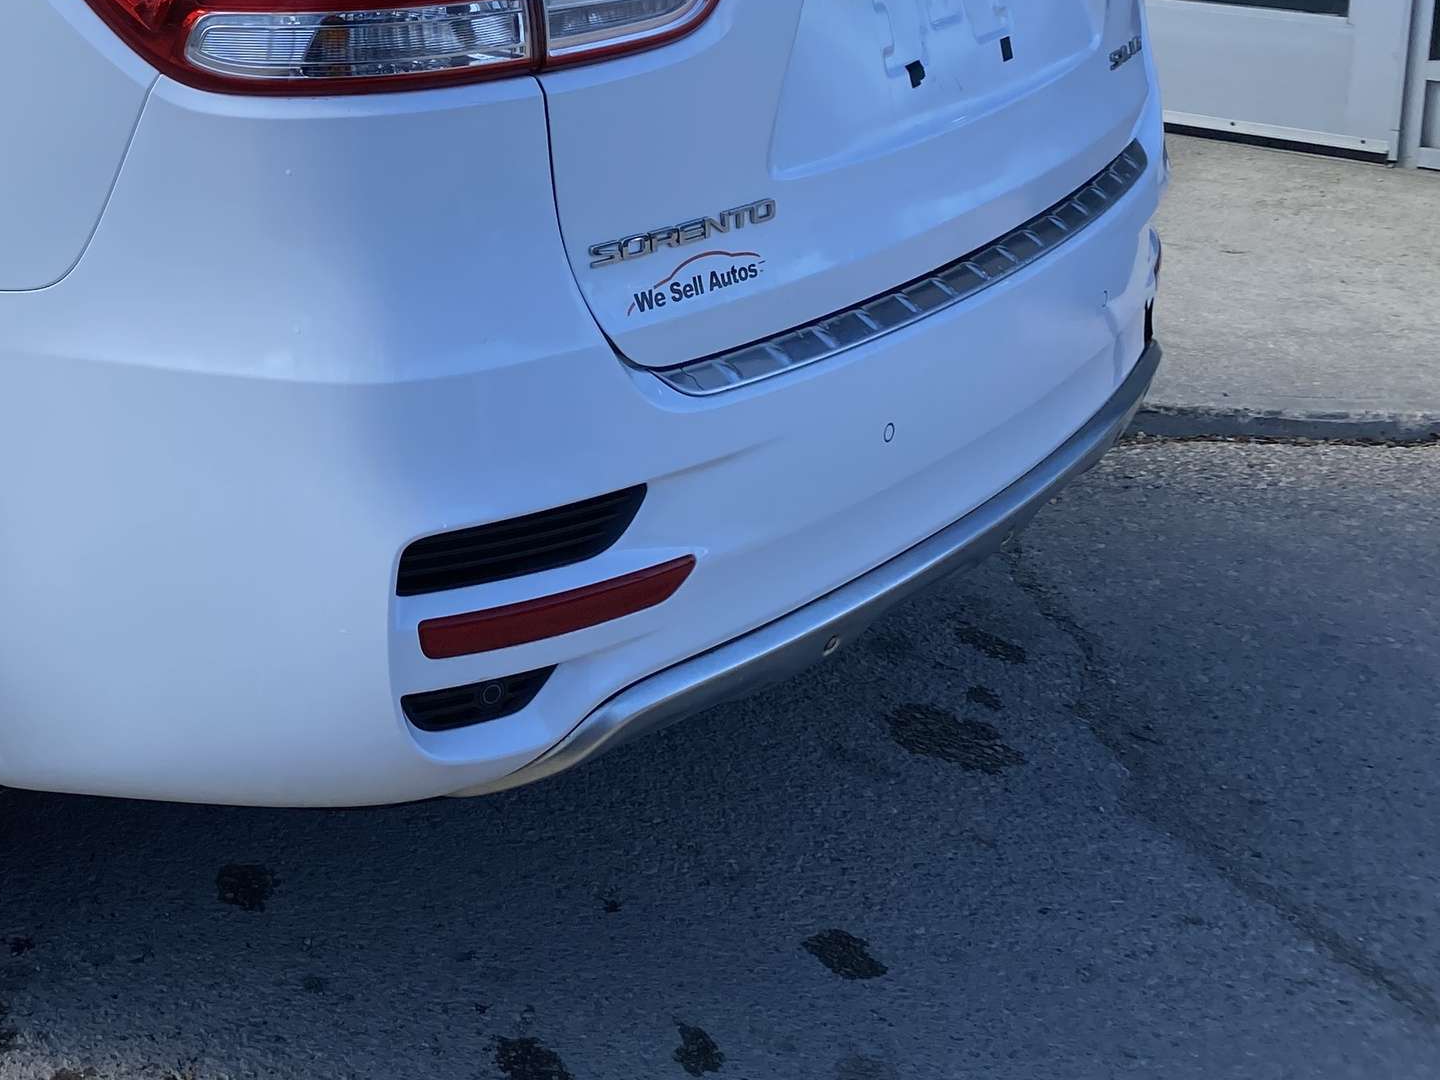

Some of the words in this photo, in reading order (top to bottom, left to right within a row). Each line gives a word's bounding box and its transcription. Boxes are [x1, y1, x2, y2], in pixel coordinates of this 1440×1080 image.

[587, 197, 777, 269] SORENTO
[633, 287, 667, 313] We
[669, 275, 705, 303] Sell
[709, 262, 759, 293] Autos
